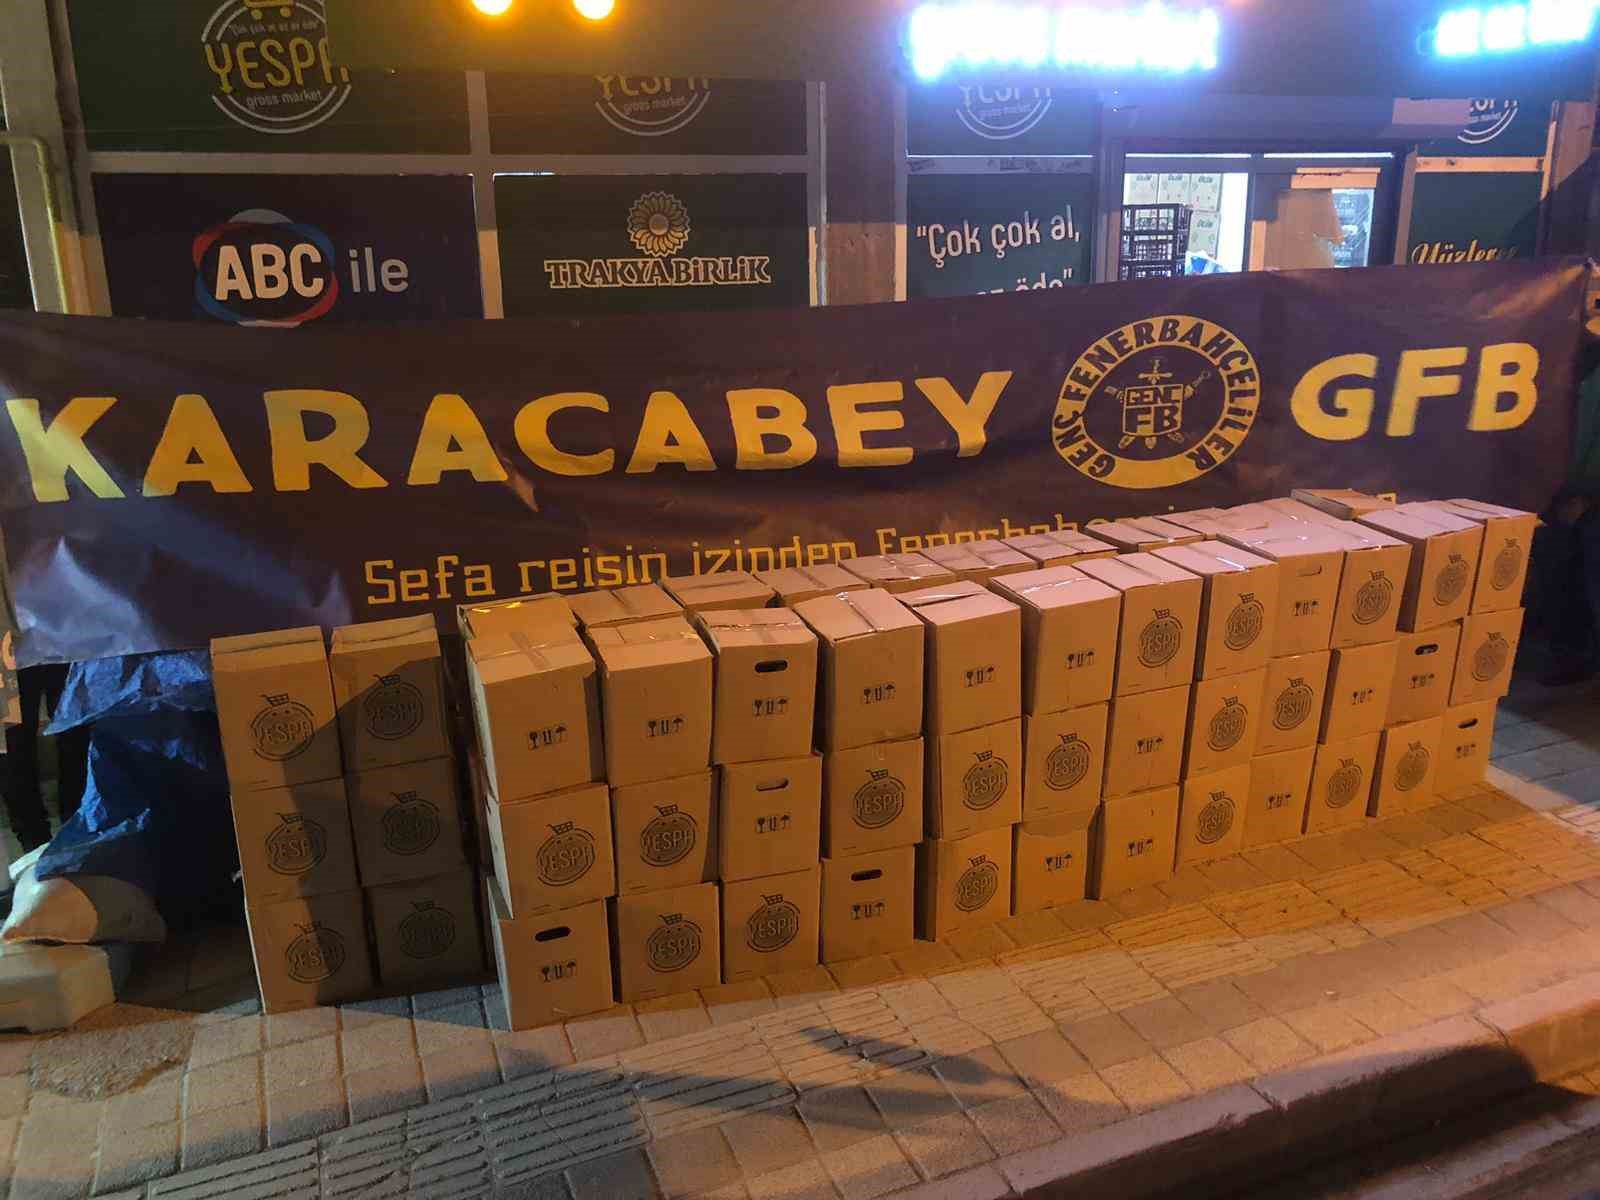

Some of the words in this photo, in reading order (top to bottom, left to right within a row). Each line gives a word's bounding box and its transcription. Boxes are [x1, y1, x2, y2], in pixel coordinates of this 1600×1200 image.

[991, 210, 1041, 258] çok
[1050, 204, 1080, 242] al,
[215, 243, 324, 300] ABC
[348, 246, 409, 293] ile
[3, 370, 1013, 503] KARACABEY
[1289, 341, 1540, 441] GFB
[364, 554, 496, 605] Sefa
[518, 544, 668, 593] reisin
[691, 535, 857, 579] izinden
